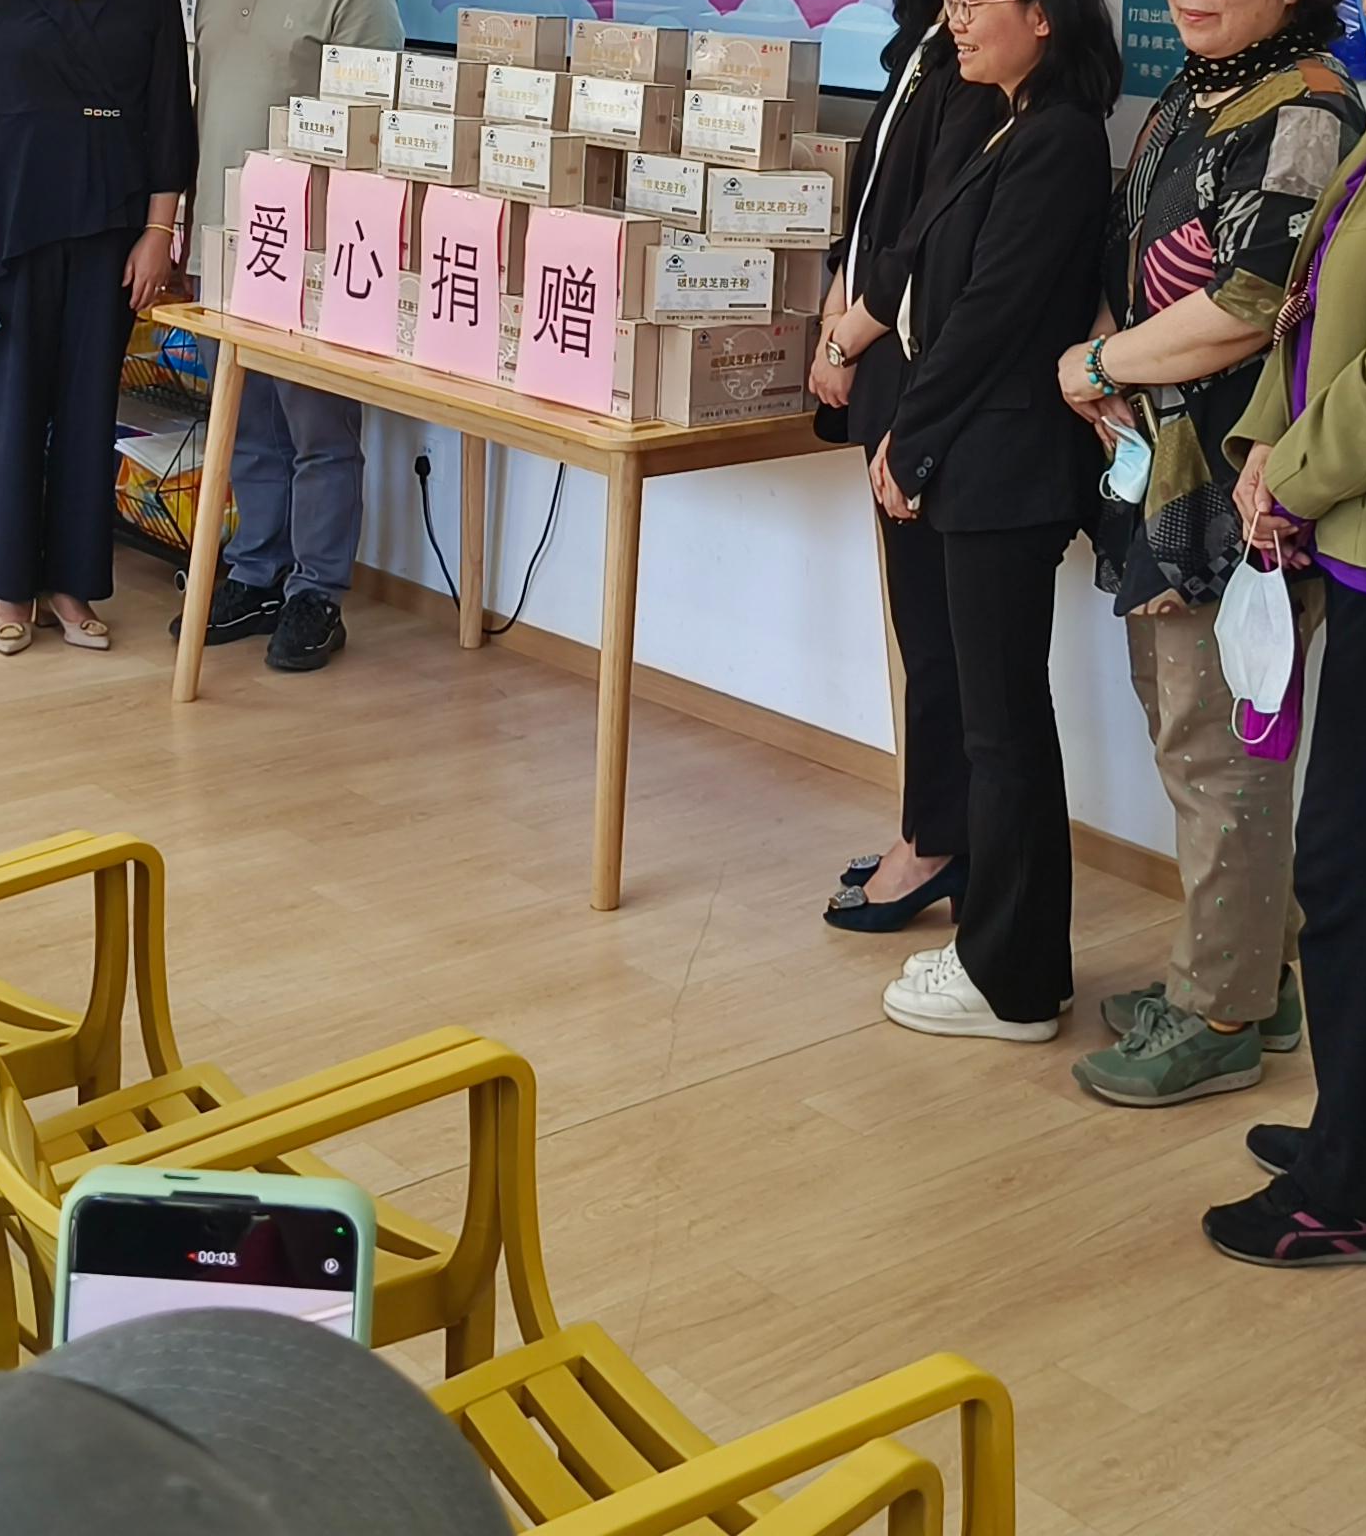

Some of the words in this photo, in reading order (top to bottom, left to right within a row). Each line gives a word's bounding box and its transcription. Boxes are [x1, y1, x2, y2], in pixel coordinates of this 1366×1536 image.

[246, 204, 596, 359] 爱心捐赠
[198, 1250, 237, 1265] 00:03
